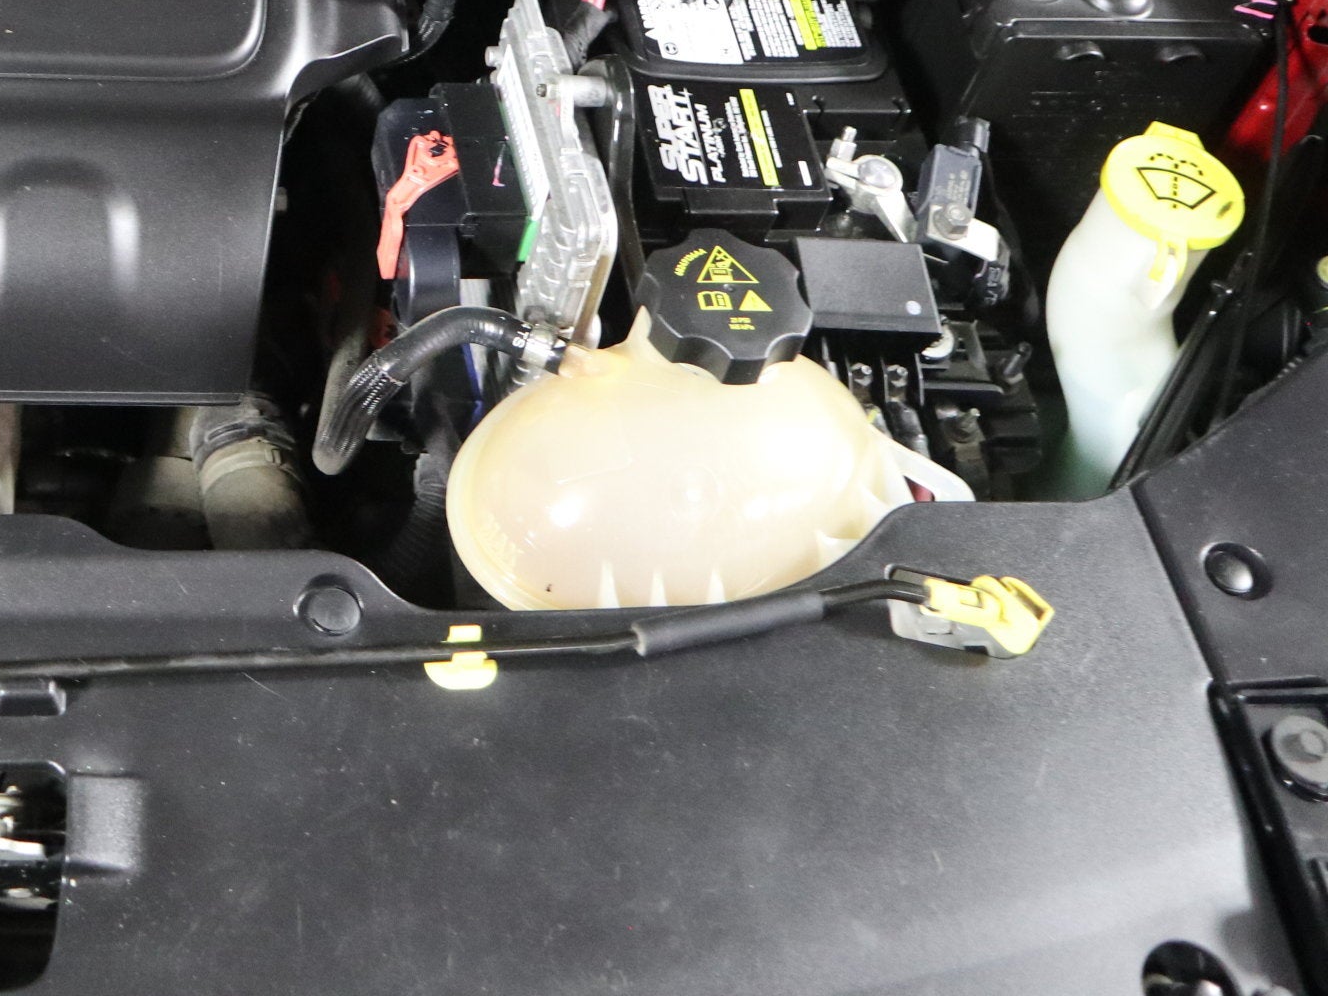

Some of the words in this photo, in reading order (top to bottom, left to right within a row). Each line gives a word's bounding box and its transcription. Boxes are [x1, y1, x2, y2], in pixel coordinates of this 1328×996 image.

[647, 84, 678, 171] SUPER
[673, 90, 709, 185] START
[694, 103, 727, 183] PLATINUM
